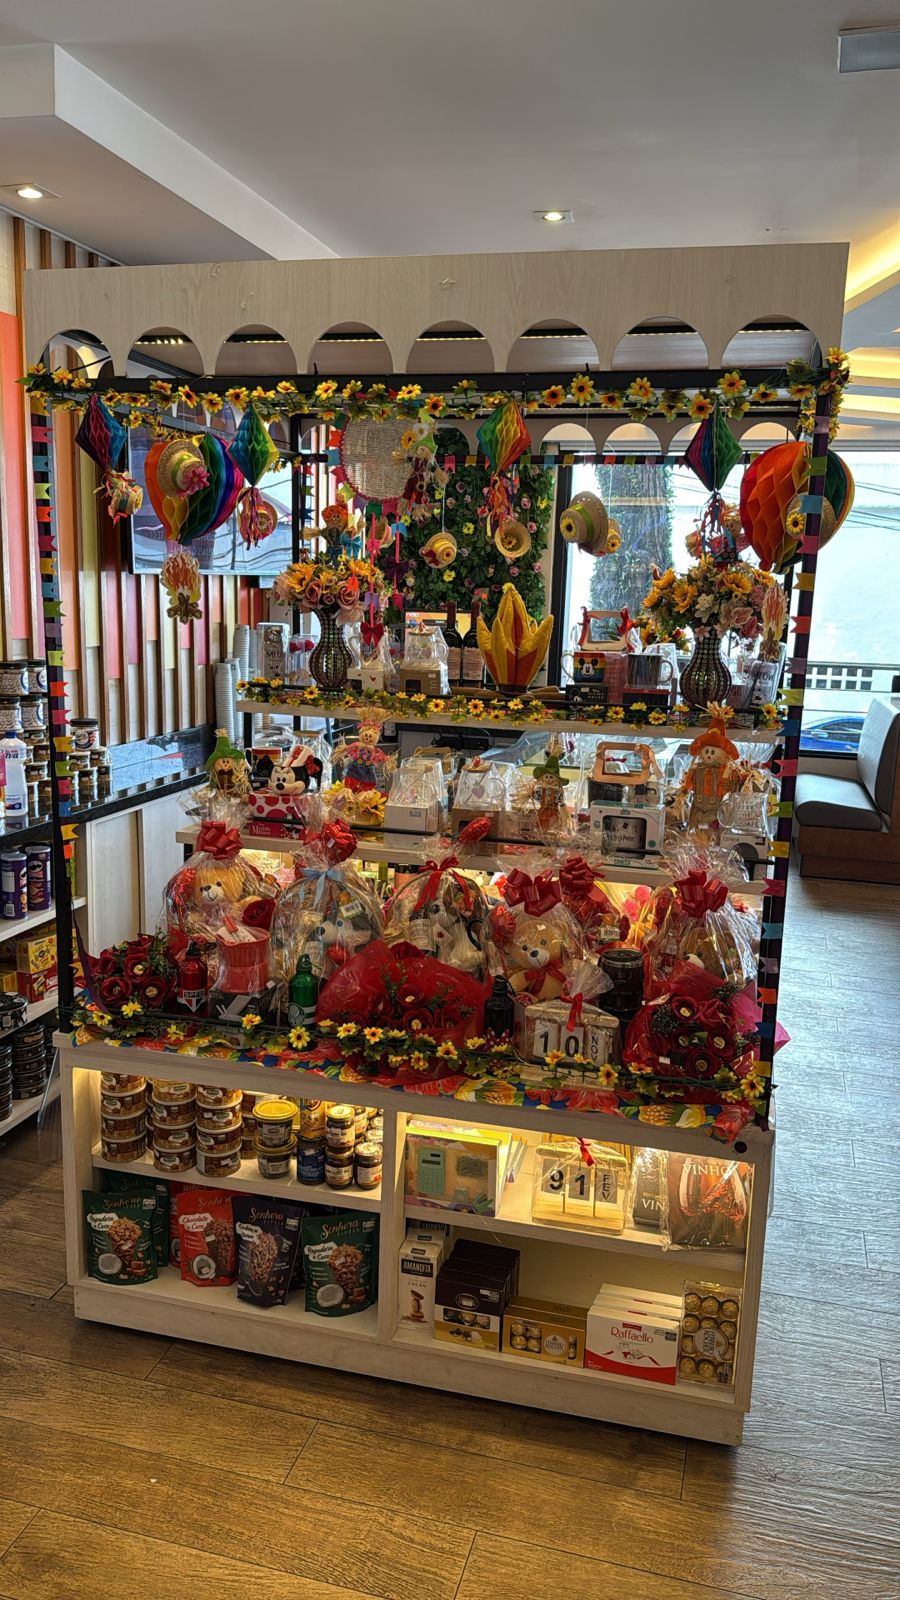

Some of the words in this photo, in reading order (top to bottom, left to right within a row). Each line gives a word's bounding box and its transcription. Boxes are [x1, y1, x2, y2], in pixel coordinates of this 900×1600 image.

[540, 1032, 549, 1054] 1
[565, 1035, 580, 1057] 0
[550, 1169, 564, 1190] 9
[575, 1174, 585, 1196] 1
[602, 1174, 610, 1200] FEV
[249, 1207, 284, 1222] Senhora
[320, 1220, 359, 1240] Senhora
[611, 1326, 654, 1344] Raffaello
